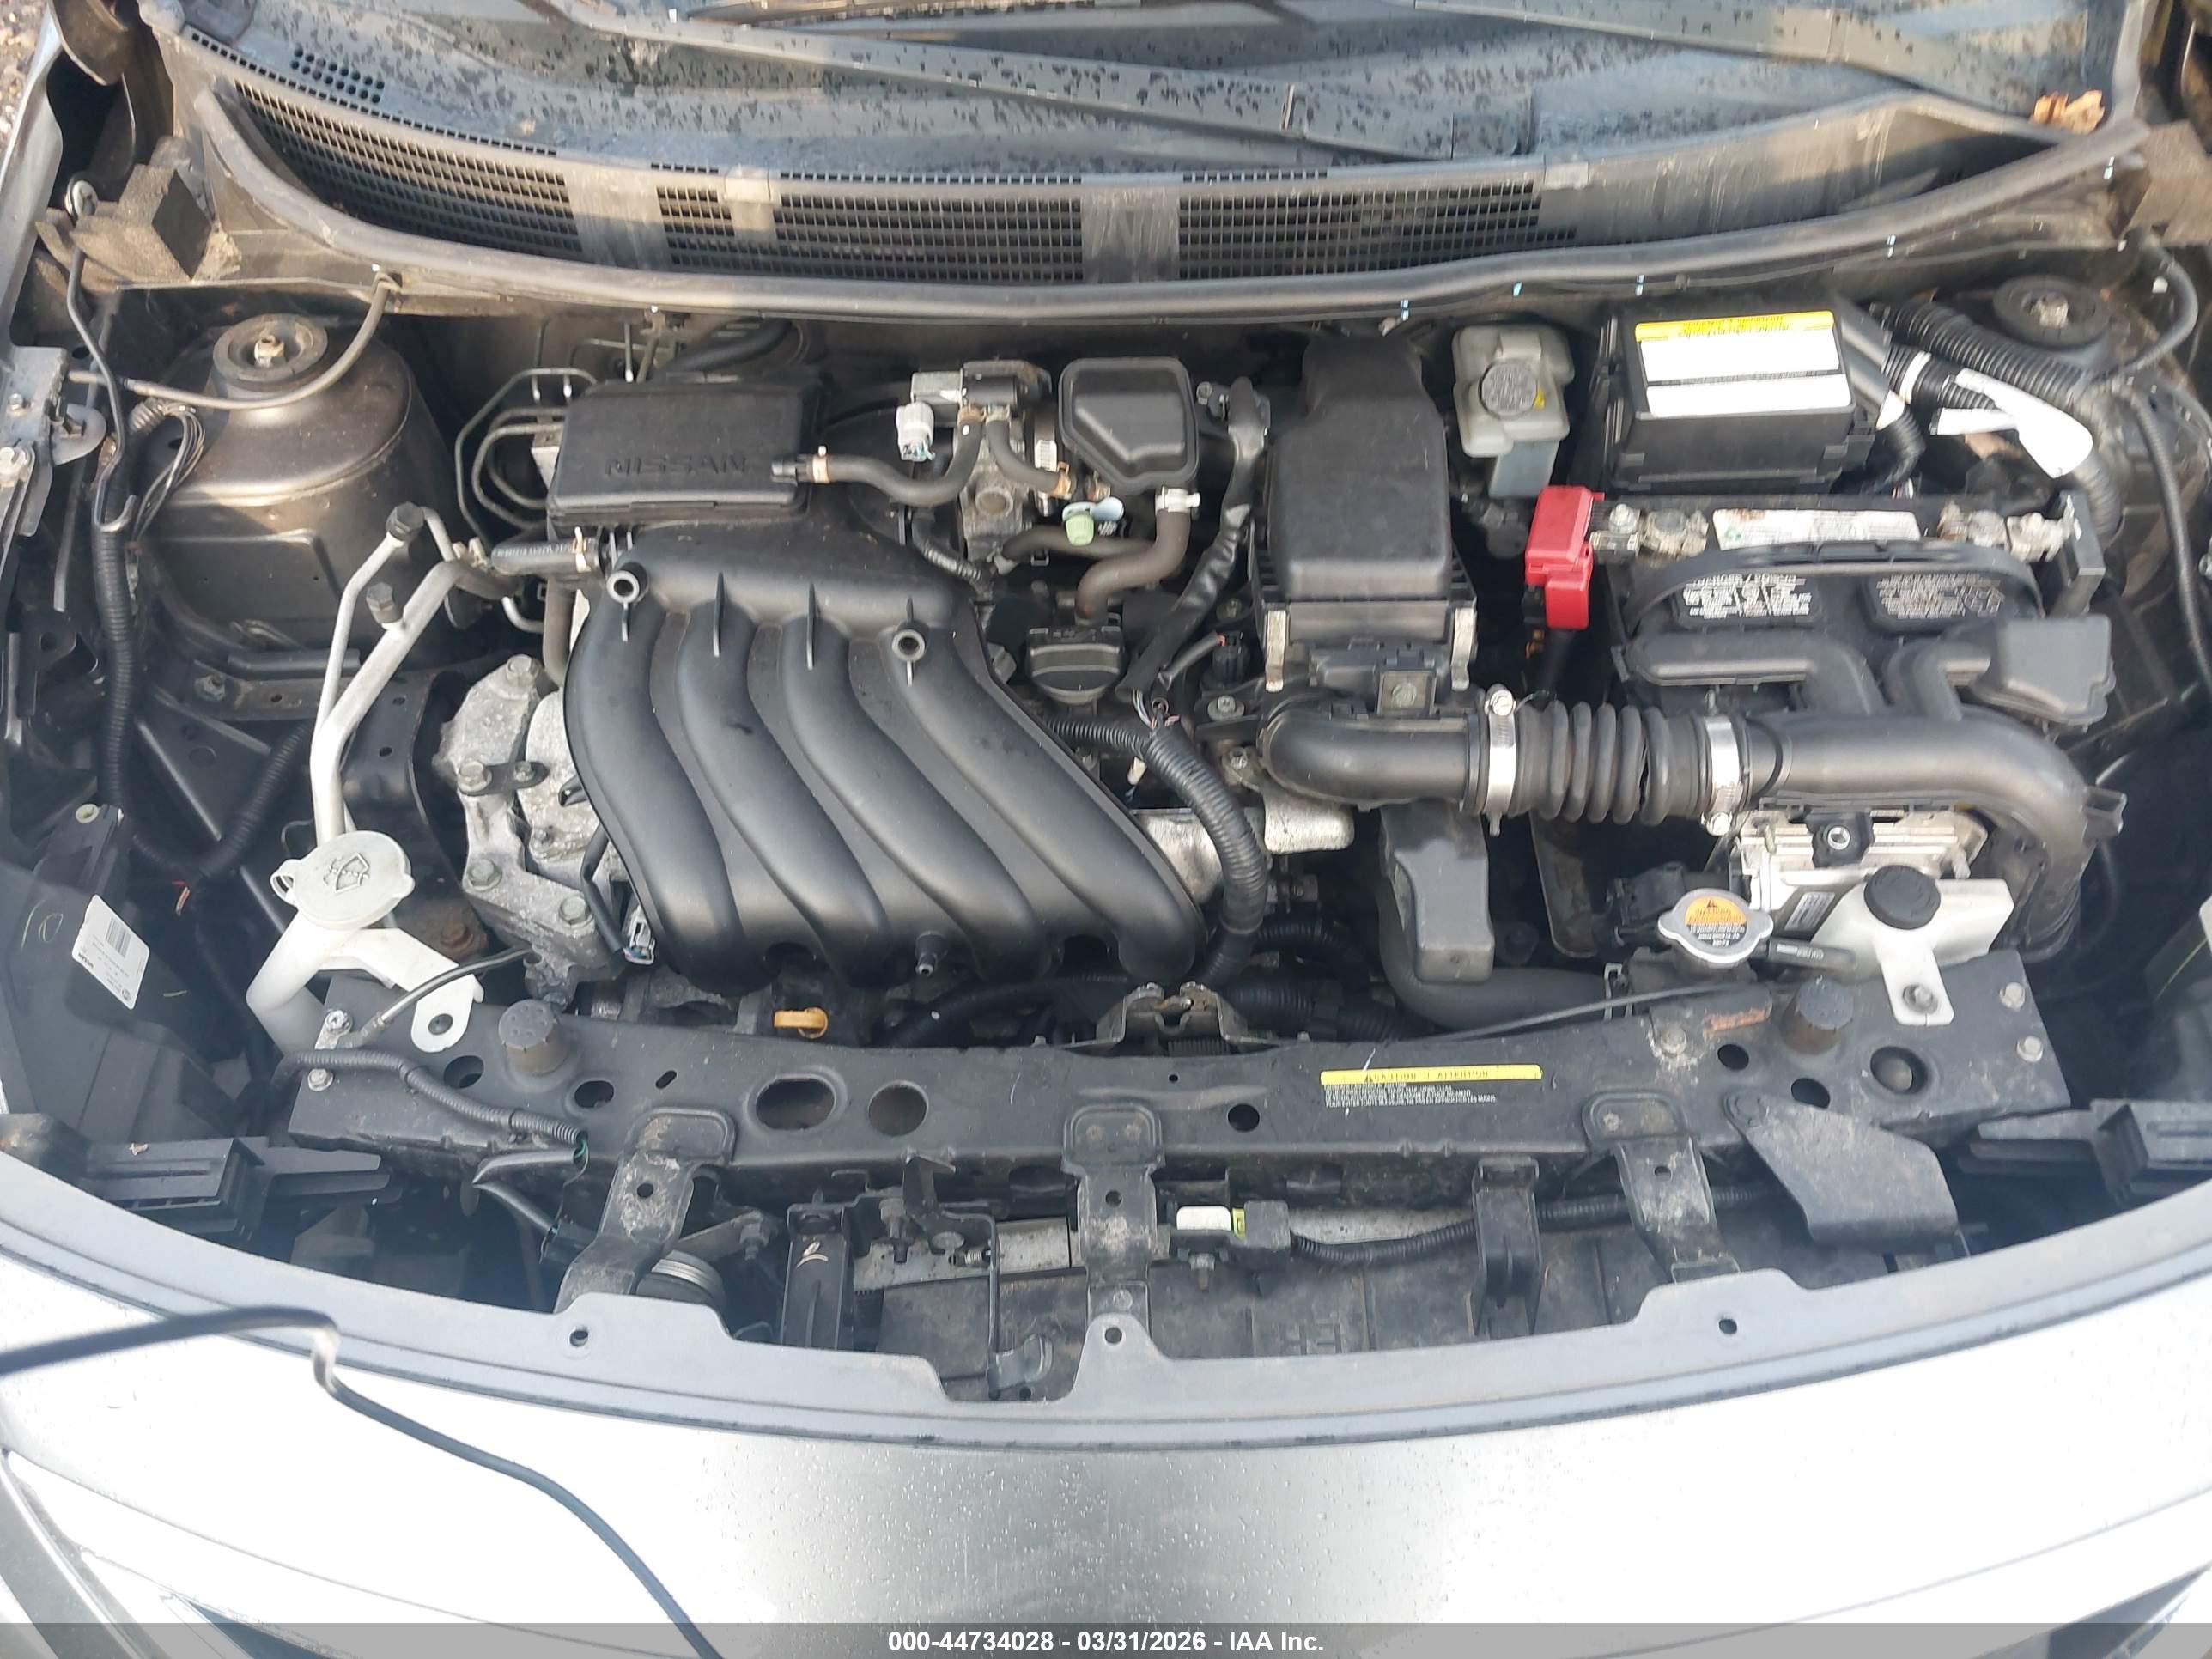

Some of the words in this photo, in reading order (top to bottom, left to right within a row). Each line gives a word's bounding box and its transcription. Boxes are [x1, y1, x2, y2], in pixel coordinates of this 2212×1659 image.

[605, 453, 747, 477] NISSAN
[1374, 1073, 1416, 1082] CAUTION
[1437, 1071, 1489, 1080] ATTENTION
